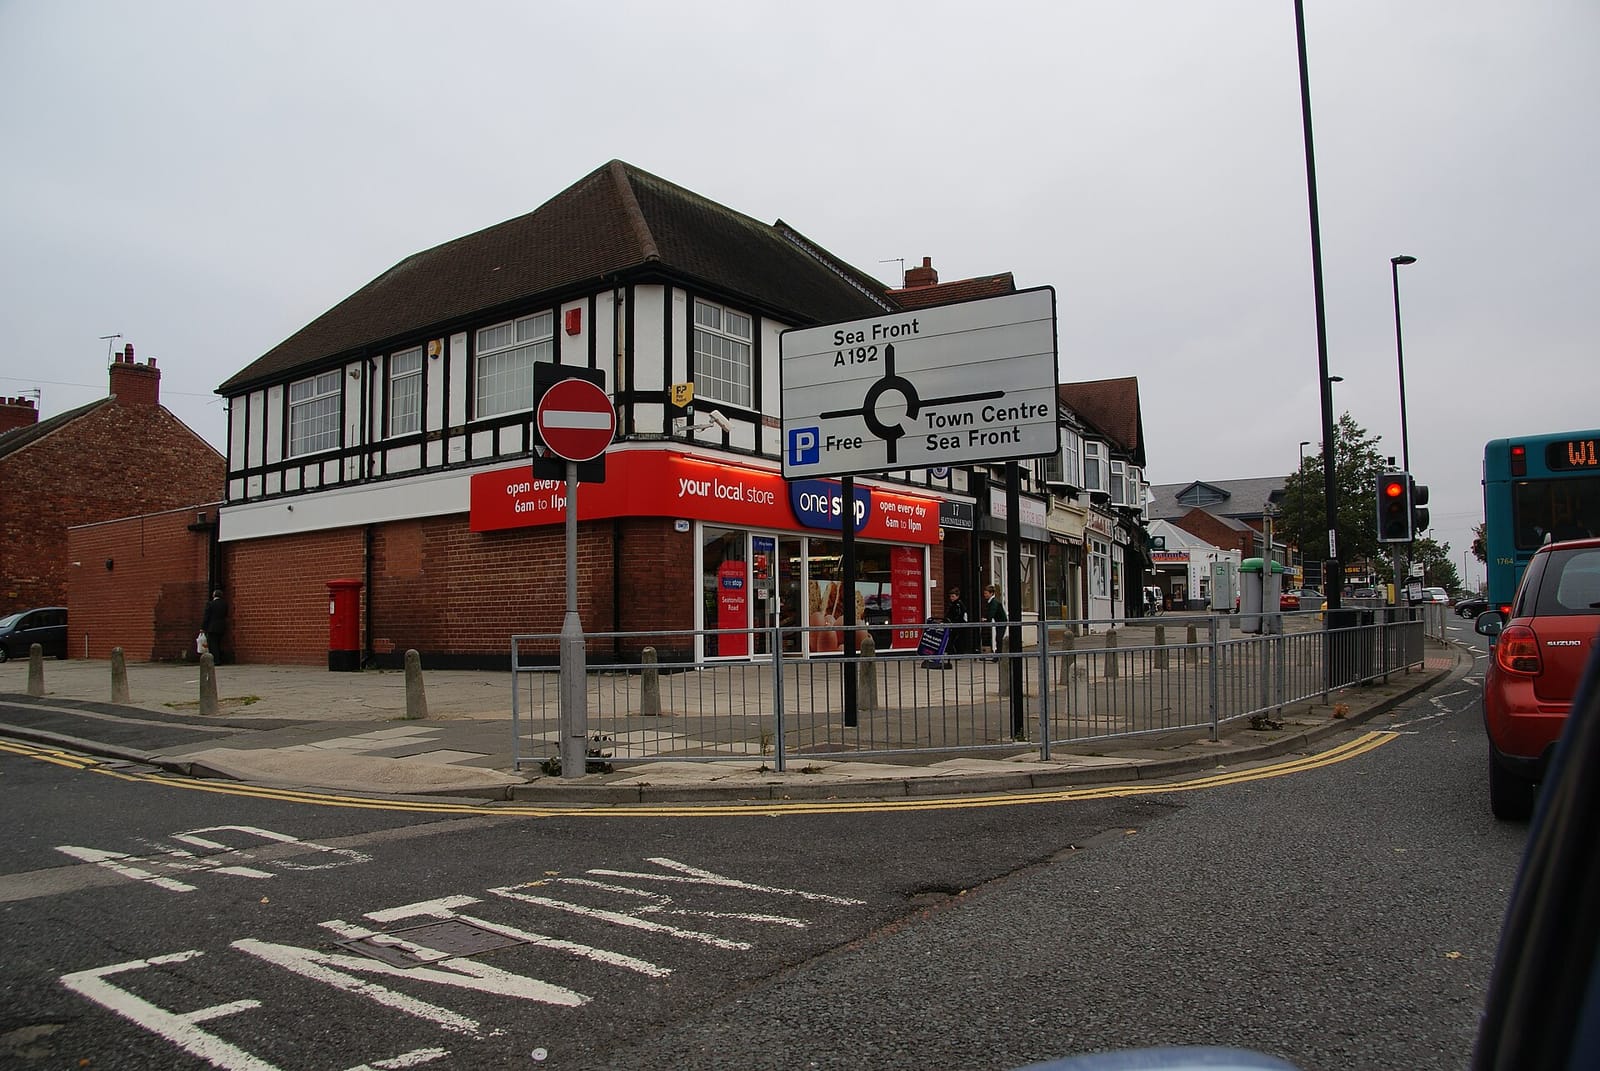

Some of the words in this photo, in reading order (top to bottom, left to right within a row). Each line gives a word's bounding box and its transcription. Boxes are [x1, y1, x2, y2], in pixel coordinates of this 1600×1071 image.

[833, 329, 865, 346] Sea
[872, 318, 920, 340] Front
[833, 345, 879, 367] A192
[925, 411, 974, 429] Town
[981, 401, 1049, 422] Centre
[795, 431, 815, 462] P
[826, 435, 863, 451] Free
[926, 433, 961, 451] Sea
[968, 426, 1021, 447] Front
[1568, 440, 1598, 465] W1
[506, 481, 530, 497] open
[533, 479, 560, 491] every
[678, 477, 711, 498] your
[714, 477, 744, 501] local
[746, 486, 775, 505] store
[514, 499, 535, 513] 6am
[538, 499, 548, 510] to
[551, 493, 567, 512] 11p
[800, 492, 828, 514] one
[879, 501, 896, 514] open
[897, 503, 914, 516] every
[915, 503, 926, 518] day
[952, 503, 960, 516] 17
[885, 516, 899, 528] 6am
[900, 519, 907, 529] to
[54, 824, 374, 892] NO
[60, 857, 867, 1071] ENTRY
